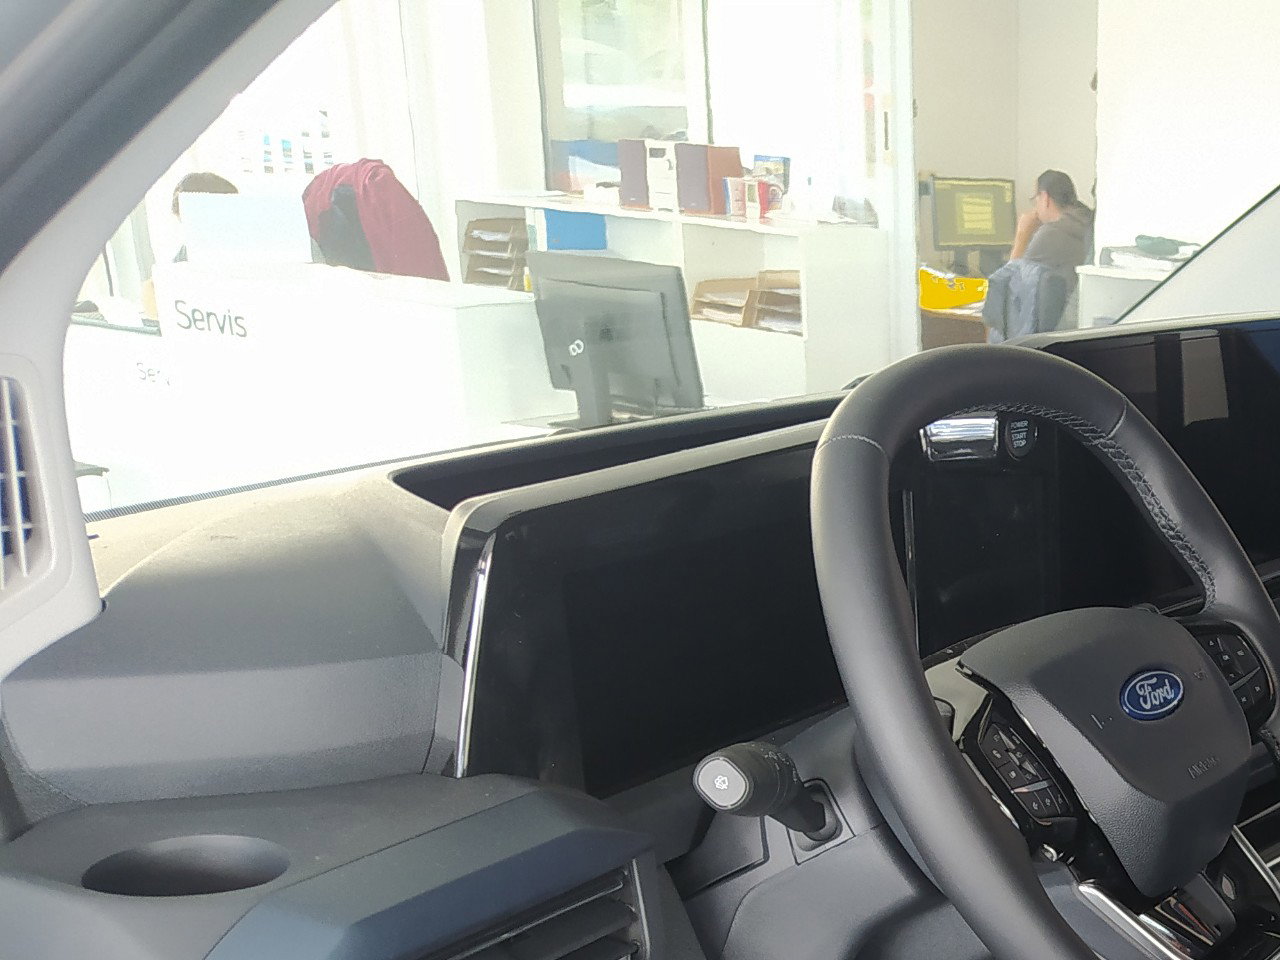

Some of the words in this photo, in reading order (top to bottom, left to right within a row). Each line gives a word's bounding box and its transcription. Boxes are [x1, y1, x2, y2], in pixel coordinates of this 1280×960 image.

[174, 299, 248, 338] Servis
[1010, 420, 1029, 429] POWER
[1011, 432, 1027, 440] START
[1013, 440, 1027, 448] STOP
[1134, 675, 1176, 710] Ford
